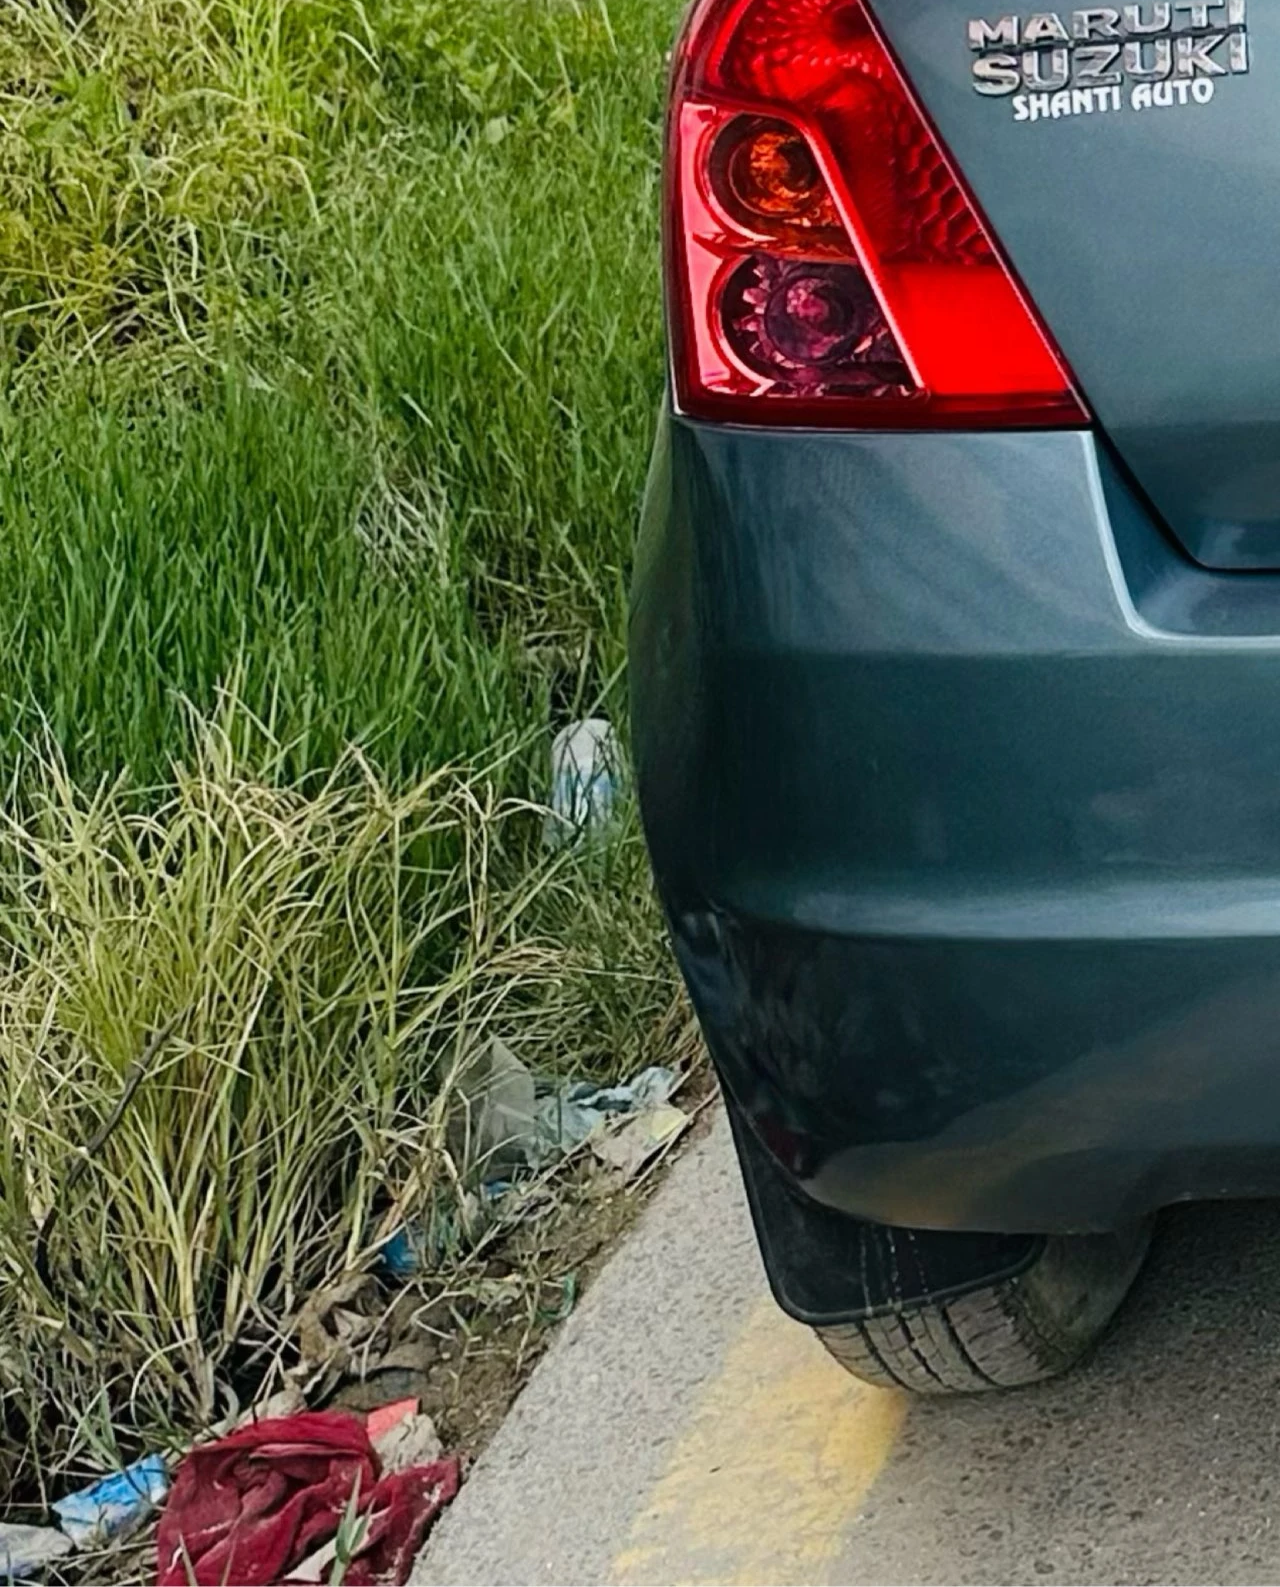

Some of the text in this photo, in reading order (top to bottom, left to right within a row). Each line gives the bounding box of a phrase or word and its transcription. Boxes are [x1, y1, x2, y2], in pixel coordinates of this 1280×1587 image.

[971, 31, 1250, 96] SUZUKI
[1012, 76, 1215, 122] SHANTI AUTO
